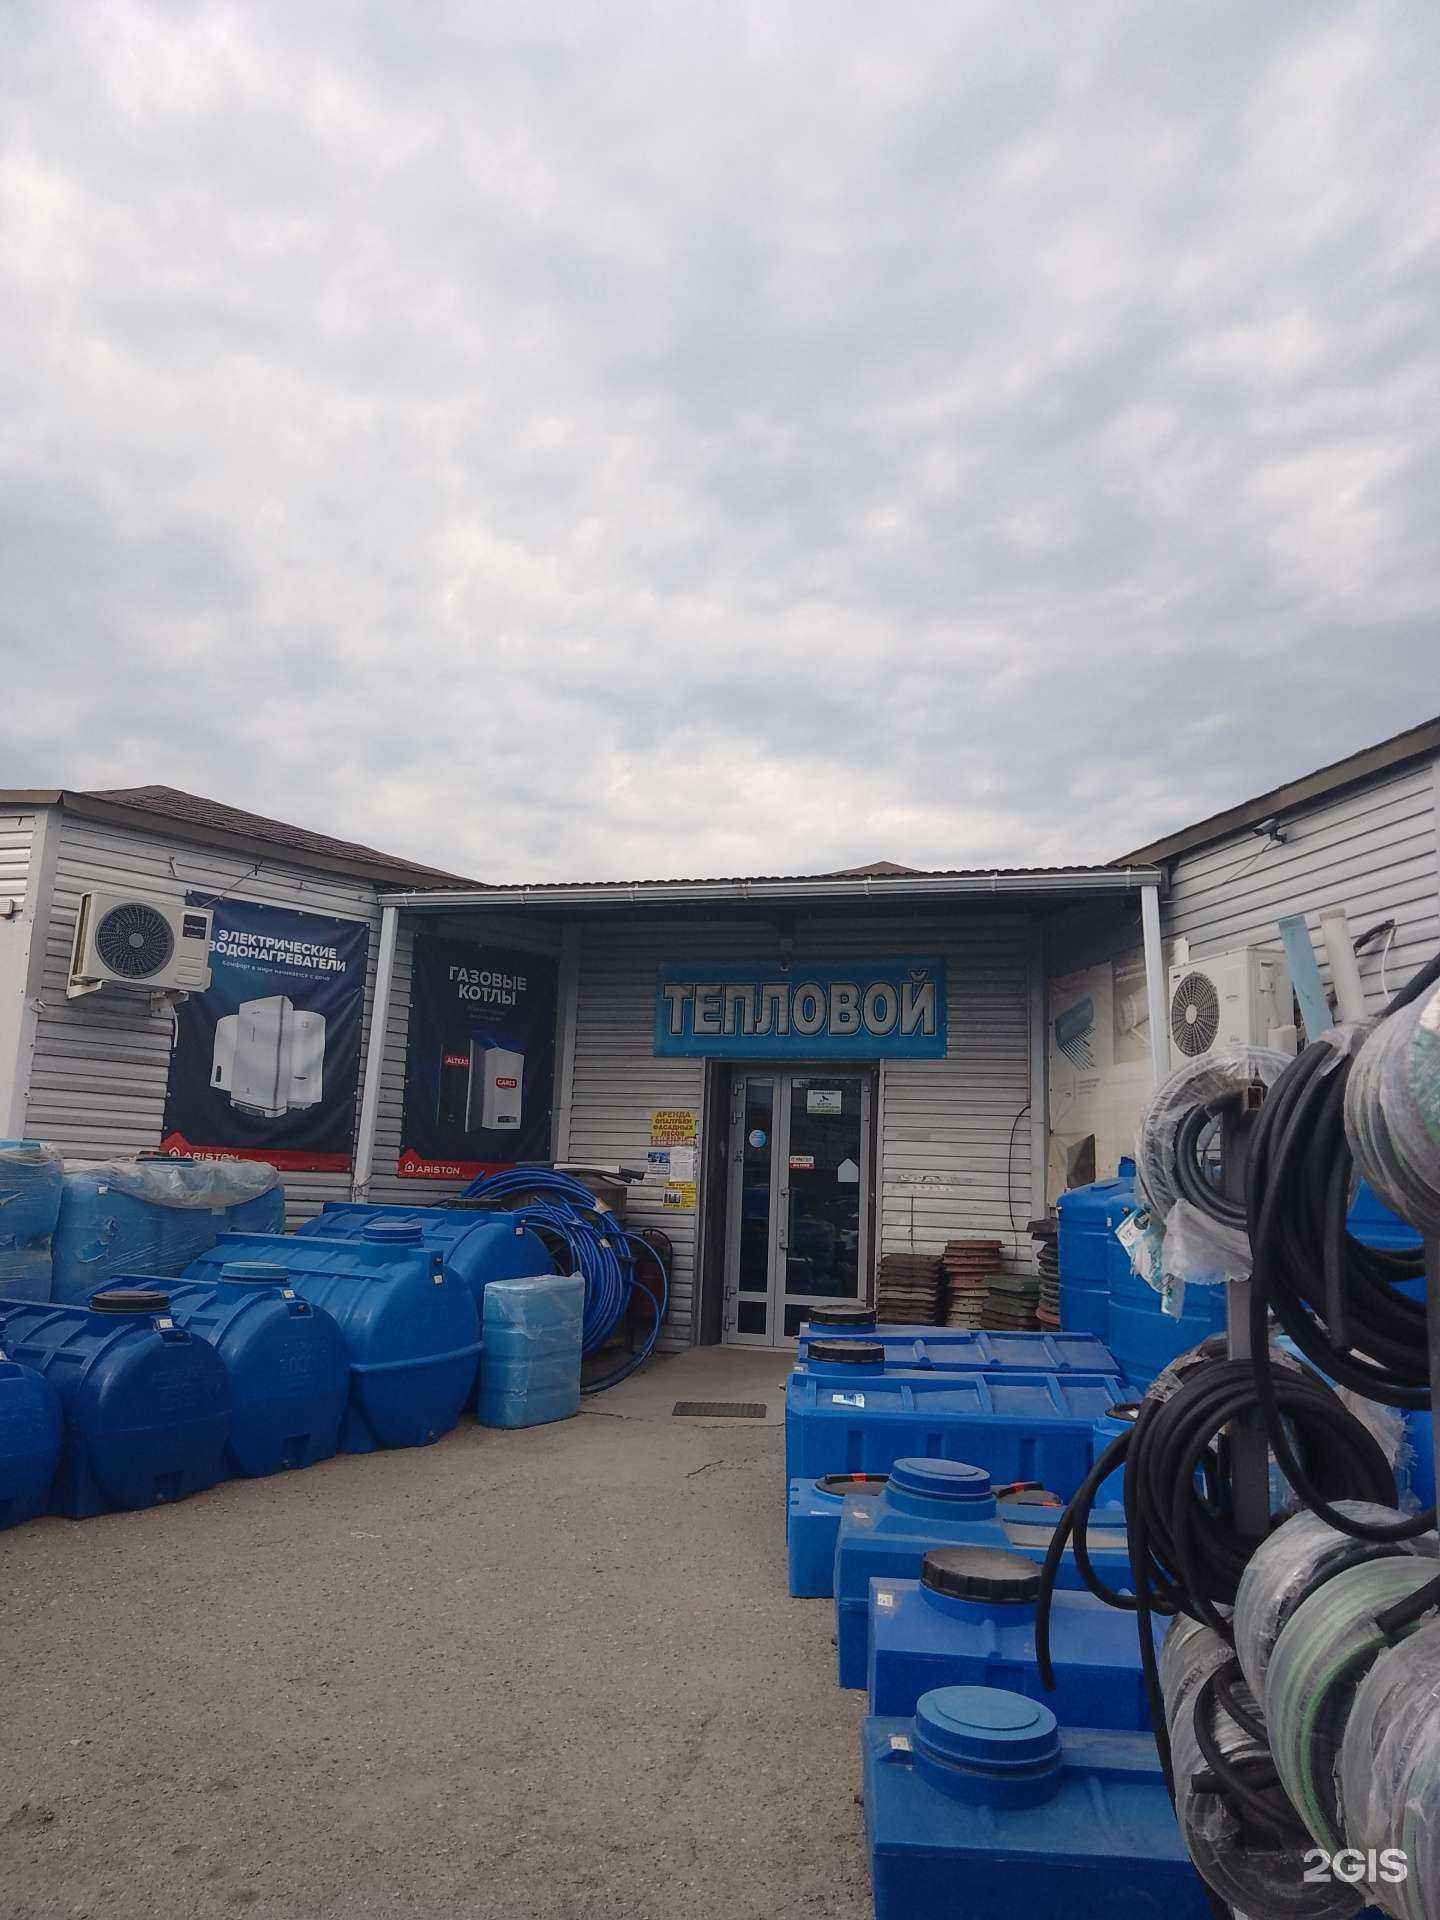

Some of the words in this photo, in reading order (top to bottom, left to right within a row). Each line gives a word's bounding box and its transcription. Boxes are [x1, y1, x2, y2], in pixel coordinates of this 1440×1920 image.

[218, 929, 338, 959] ЭЛЕКТРИЧЕСКИЕ
[222, 960, 251, 971] Комфорт
[449, 966, 528, 991] ГАЗОВЫЕ
[458, 983, 516, 1006] КОТЛЫ
[662, 969, 938, 1037] ТЕПЛОВОЙ
[656, 1111, 691, 1120] АРЕНДА
[416, 1165, 461, 1176] ARISTON
